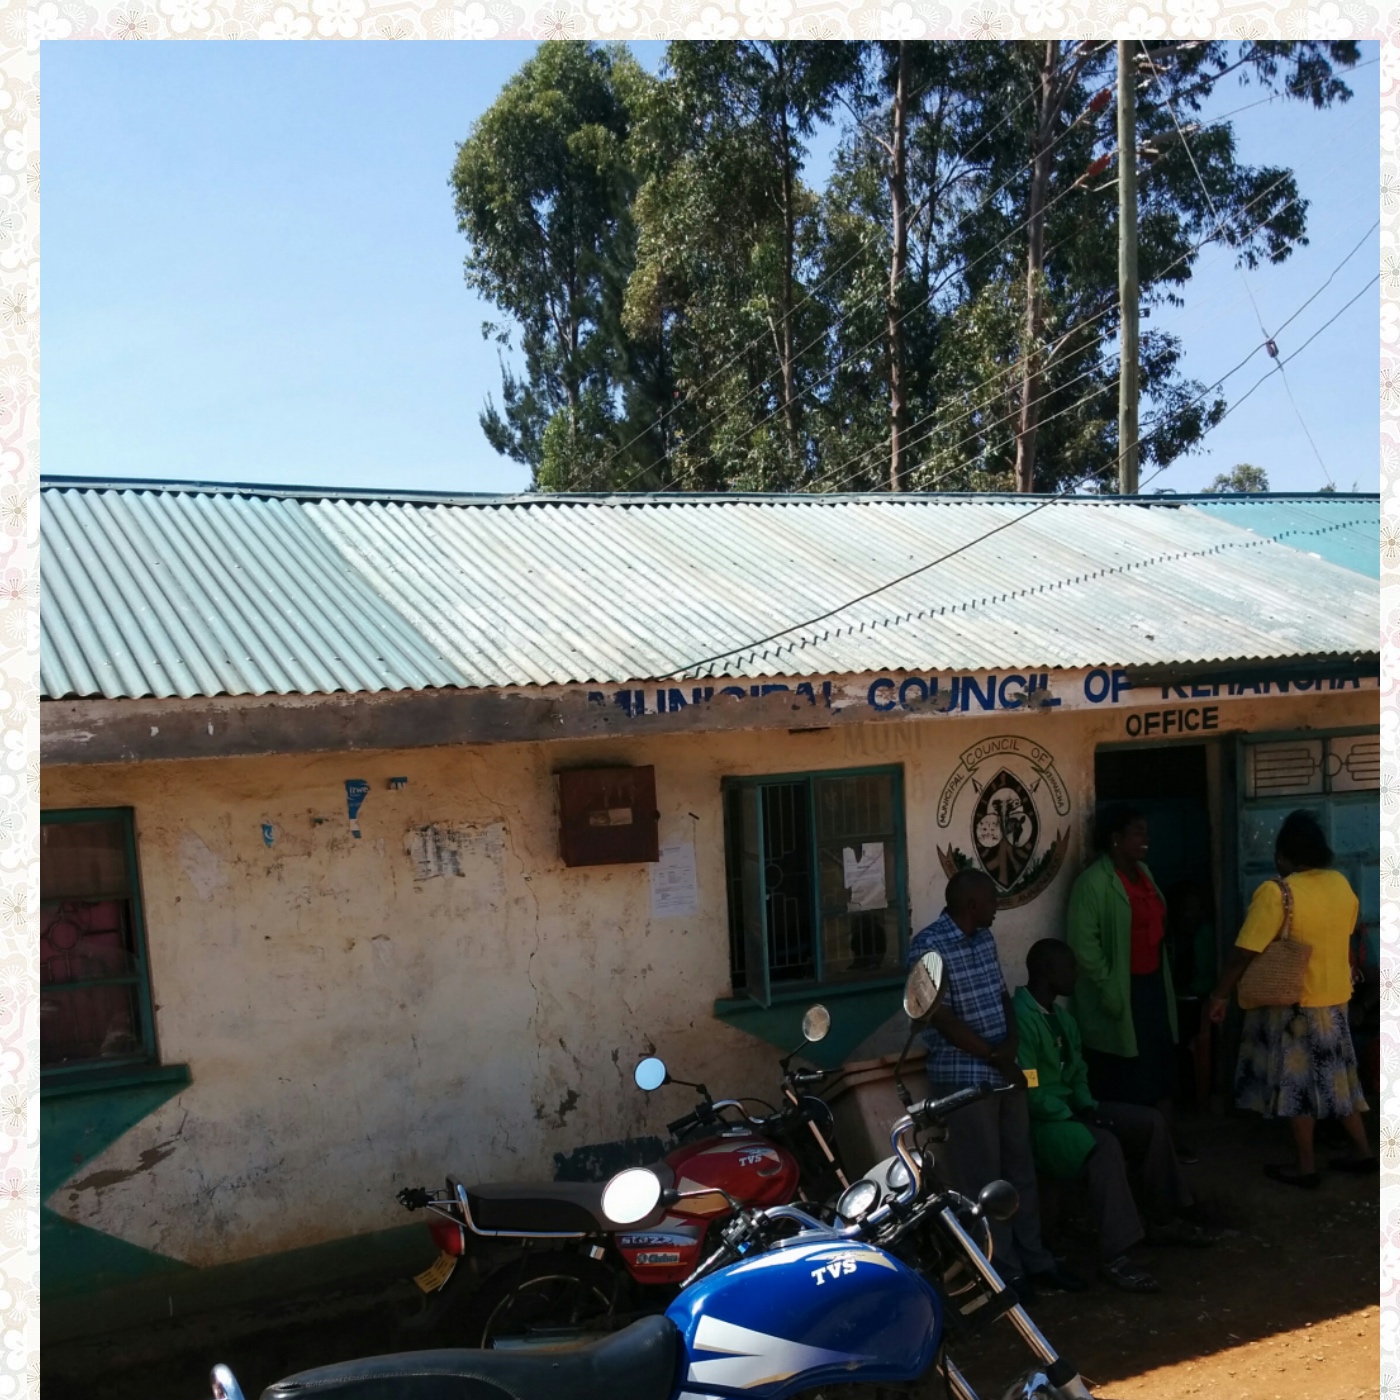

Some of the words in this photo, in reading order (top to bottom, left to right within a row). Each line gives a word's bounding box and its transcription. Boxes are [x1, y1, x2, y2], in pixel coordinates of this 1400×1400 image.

[867, 673, 1061, 711] COUNCIL
[1084, 668, 1133, 703] OF
[1125, 706, 1219, 737] OFFICE
[966, 739, 1020, 766] COUNCIL
[1031, 747, 1049, 763] OF
[739, 1154, 763, 1167] TVS
[811, 1257, 857, 1286] TVS
